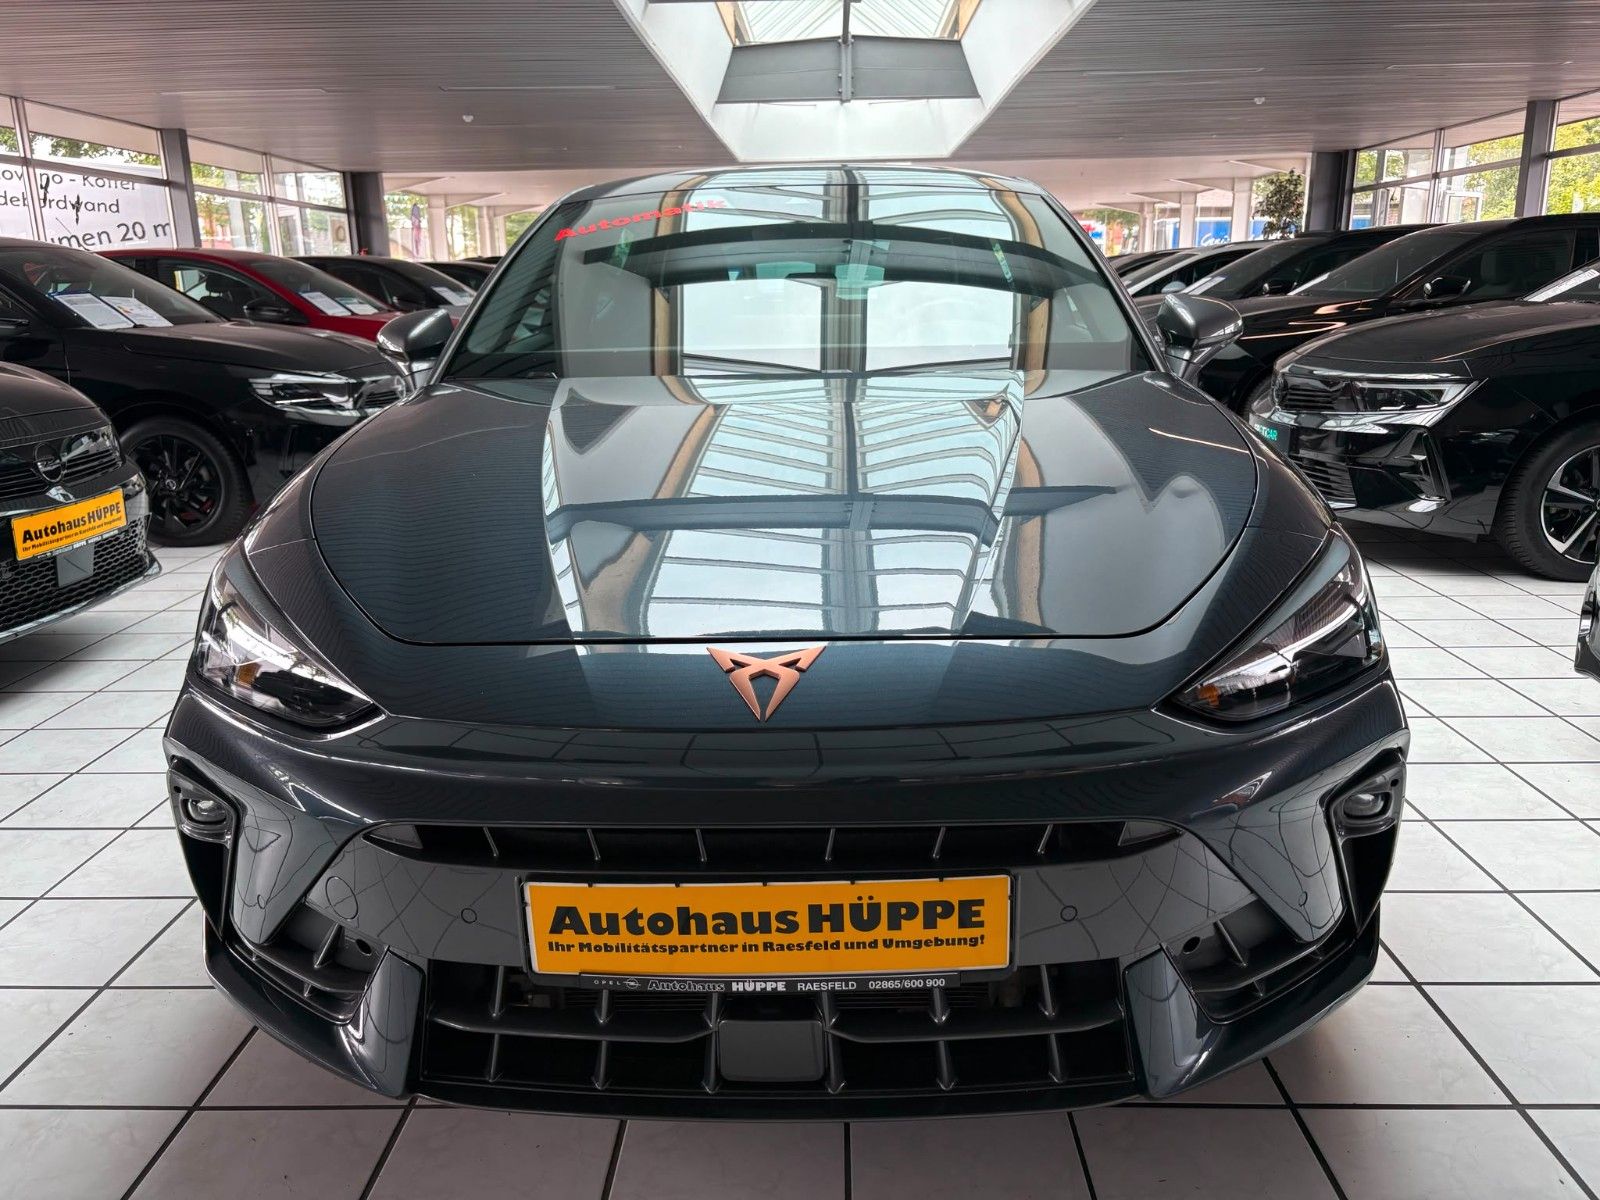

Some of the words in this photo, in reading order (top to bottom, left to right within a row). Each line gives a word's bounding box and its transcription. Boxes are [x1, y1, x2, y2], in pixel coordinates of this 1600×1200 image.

[116, 221, 146, 242] 20
[554, 200, 727, 241] Automatik
[22, 516, 87, 544] Autohaus
[87, 502, 122, 523] HÜPPE
[549, 906, 800, 936] Autohaus
[808, 895, 985, 933] HÜPPE
[548, 941, 575, 952] Ihr
[578, 942, 738, 955] Mobilitätspartner
[742, 942, 759, 953] in
[763, 940, 841, 952] Raesfeld
[844, 938, 878, 950] und
[882, 934, 985, 948] Umgebung!
[647, 980, 725, 991] Autohaus
[731, 979, 787, 992] HÜPPE
[797, 980, 858, 991] RAESFELD
[868, 979, 924, 990] 02865/600
[925, 978, 946, 988] 900
